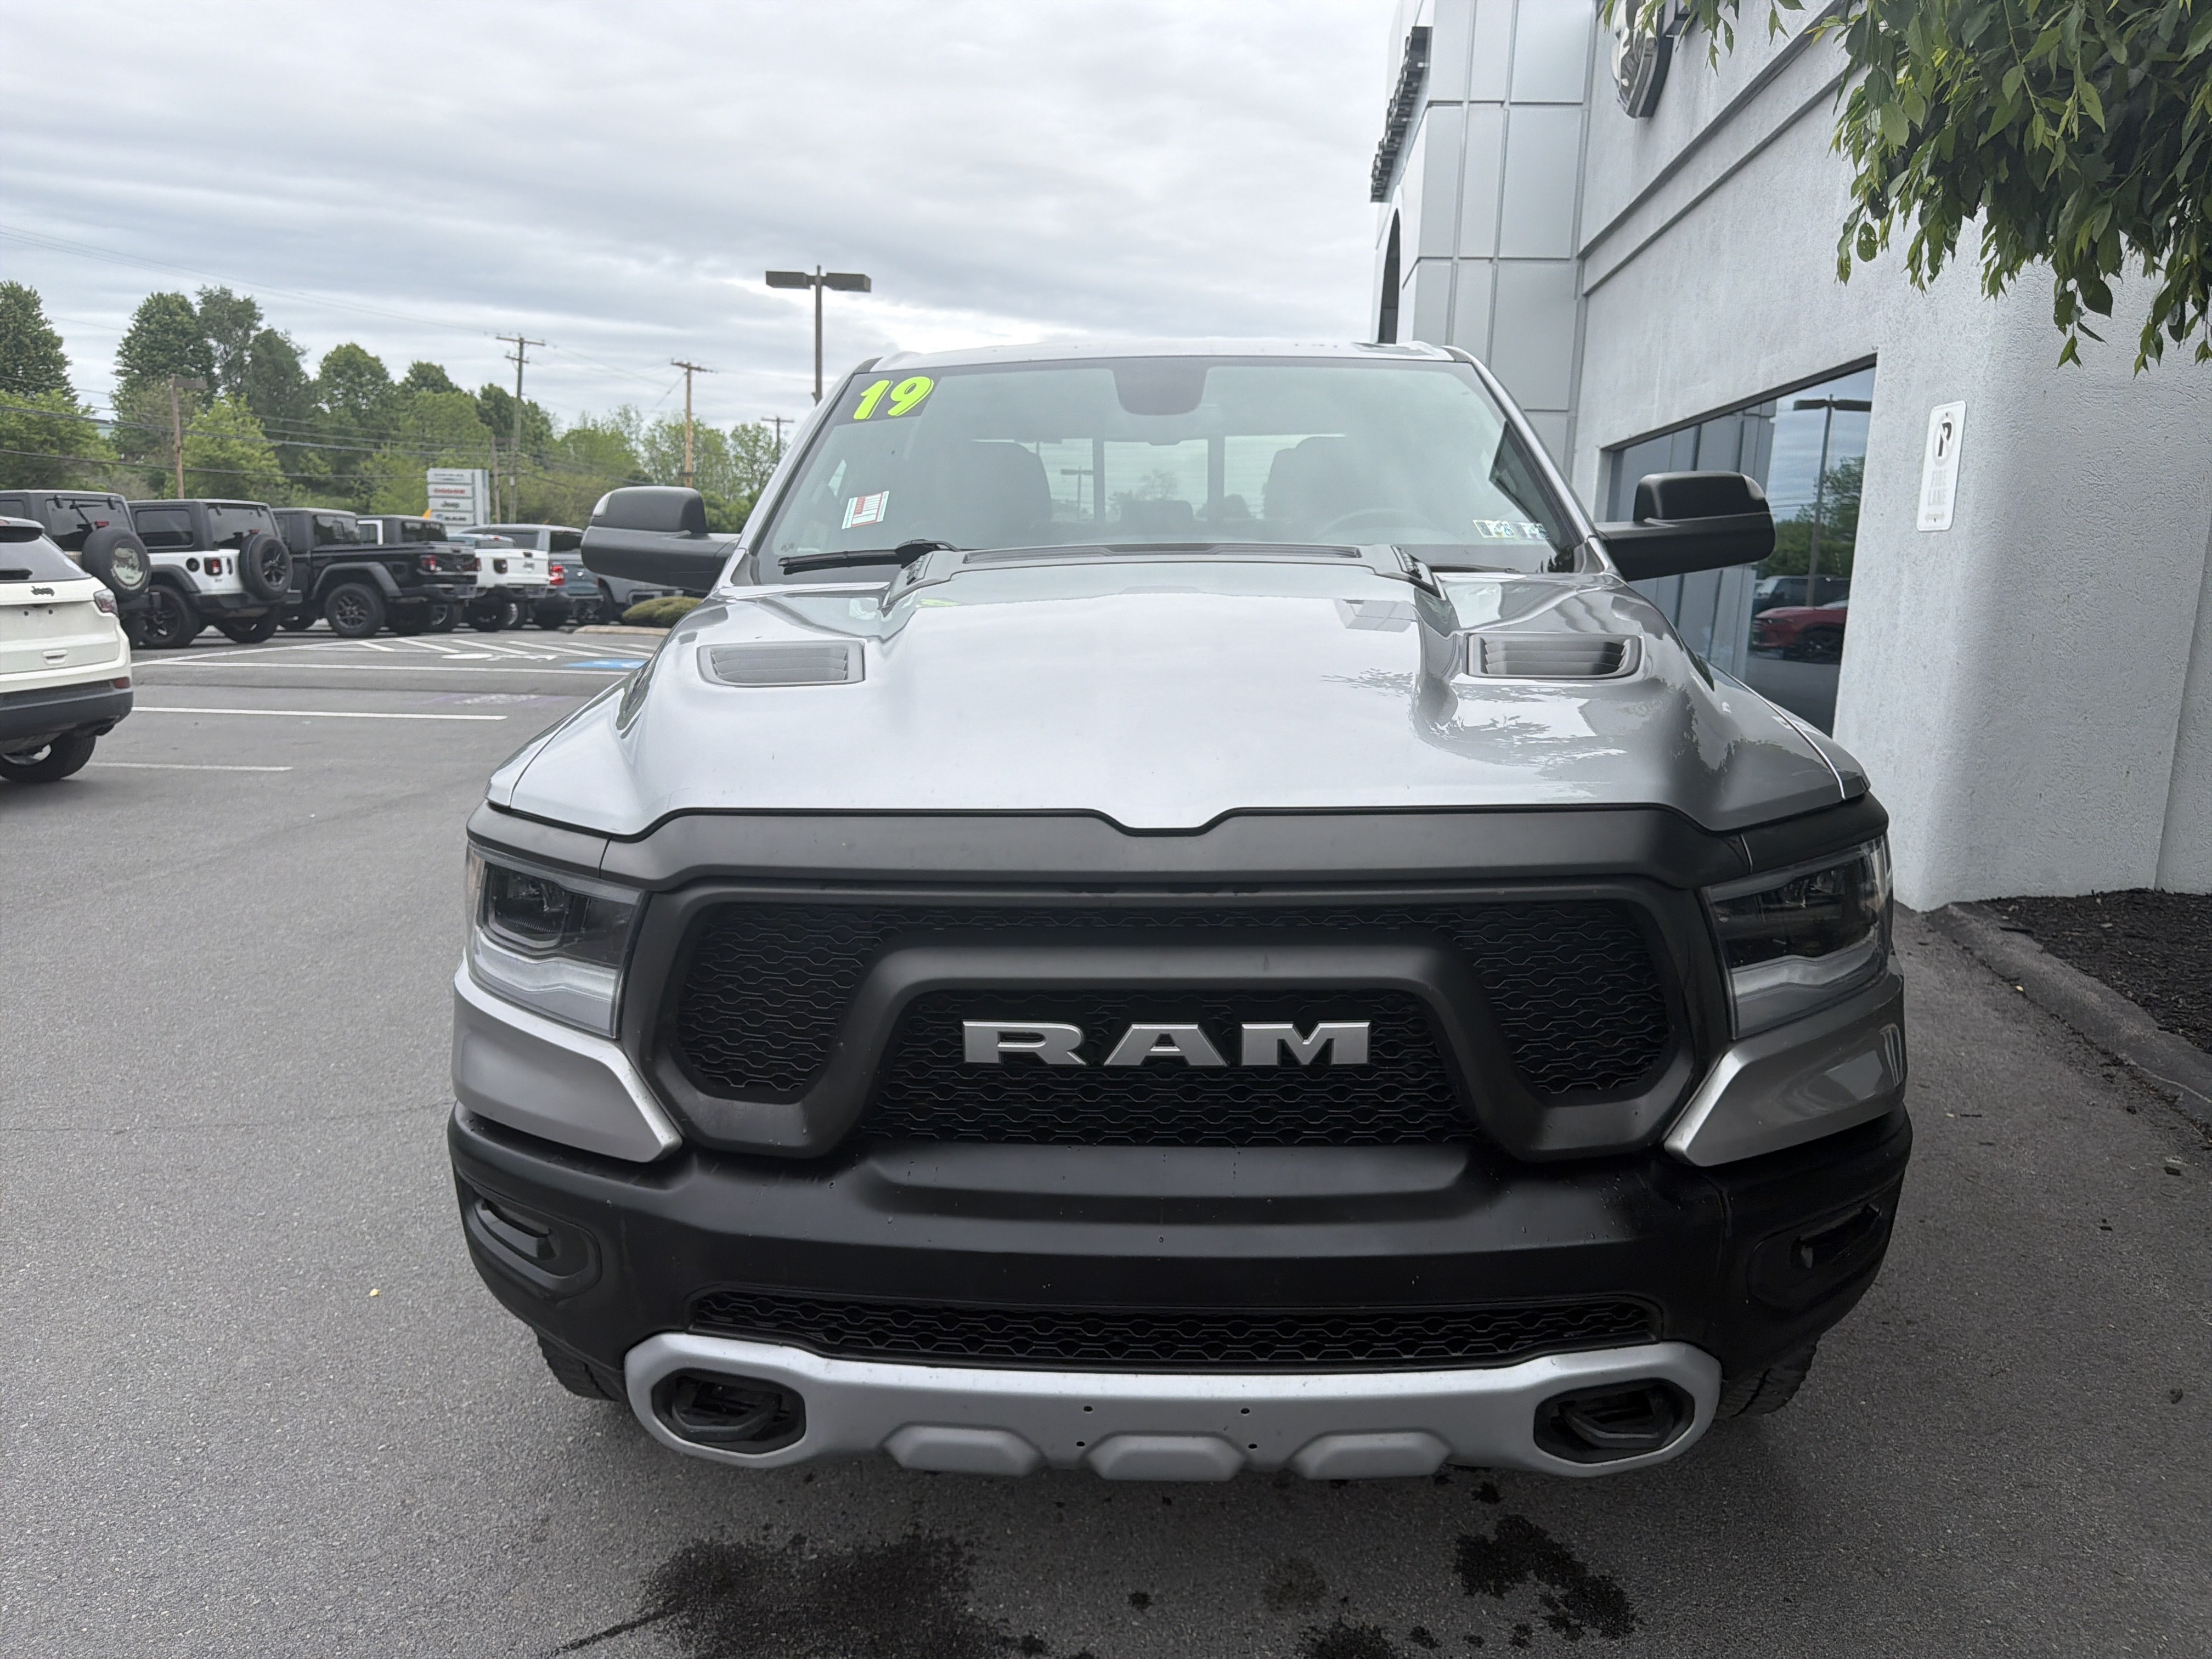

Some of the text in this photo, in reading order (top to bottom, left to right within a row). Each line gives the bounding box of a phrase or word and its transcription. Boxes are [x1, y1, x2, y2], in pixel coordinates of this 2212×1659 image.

[853, 376, 934, 420] 19
[1931, 469, 1948, 487] FIRE
[31, 585, 55, 597] Jeep
[962, 1019, 1372, 1066] RAM
